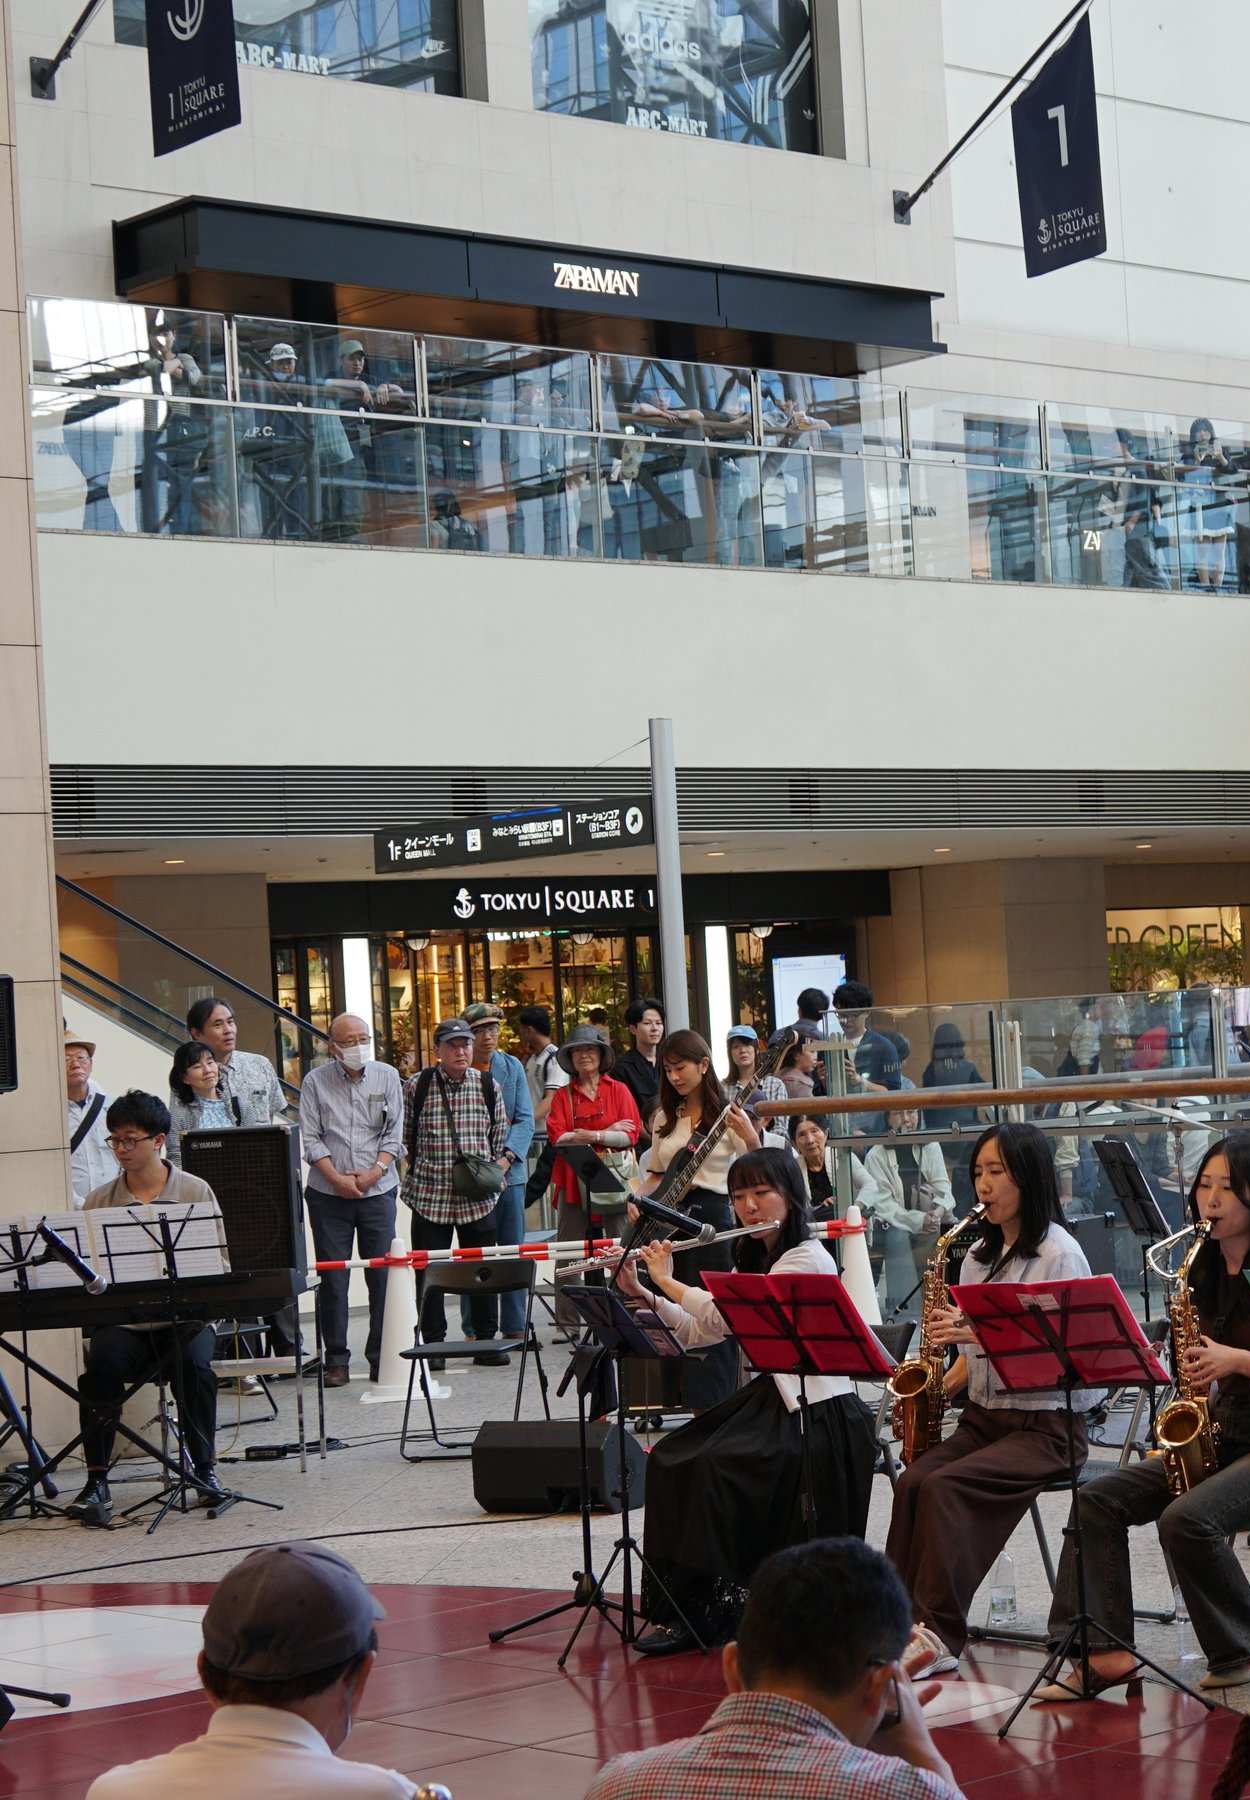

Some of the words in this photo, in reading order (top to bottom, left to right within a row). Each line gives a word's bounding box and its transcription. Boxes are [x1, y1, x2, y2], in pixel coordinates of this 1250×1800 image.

[625, 27, 701, 60] adidas
[235, 41, 330, 75] ABC-MART
[184, 75, 206, 95] TOKYU
[168, 93, 175, 120] 1
[184, 83, 225, 112] SQUARE
[168, 103, 225, 132] MINATOMIRAI
[625, 106, 708, 137] ABC-MART
[1047, 104, 1069, 167] 1
[1057, 207, 1084, 222] TOKYU
[1058, 212, 1100, 237] SQUARE
[1042, 229, 1100, 253] MINATOMIRAI
[576, 809, 620, 824] ステーションコア
[388, 840, 401, 861] 1F
[404, 832, 454, 850] クイーンモール
[405, 850, 422, 860] QUEEN
[481, 892, 540, 911] TOKYU
[554, 889, 635, 914] SQUARE
[1140, 922, 1245, 965] GREEN
[199, 1141, 223, 1149] YAMAHA
[952, 1248, 967, 1258] YAM
